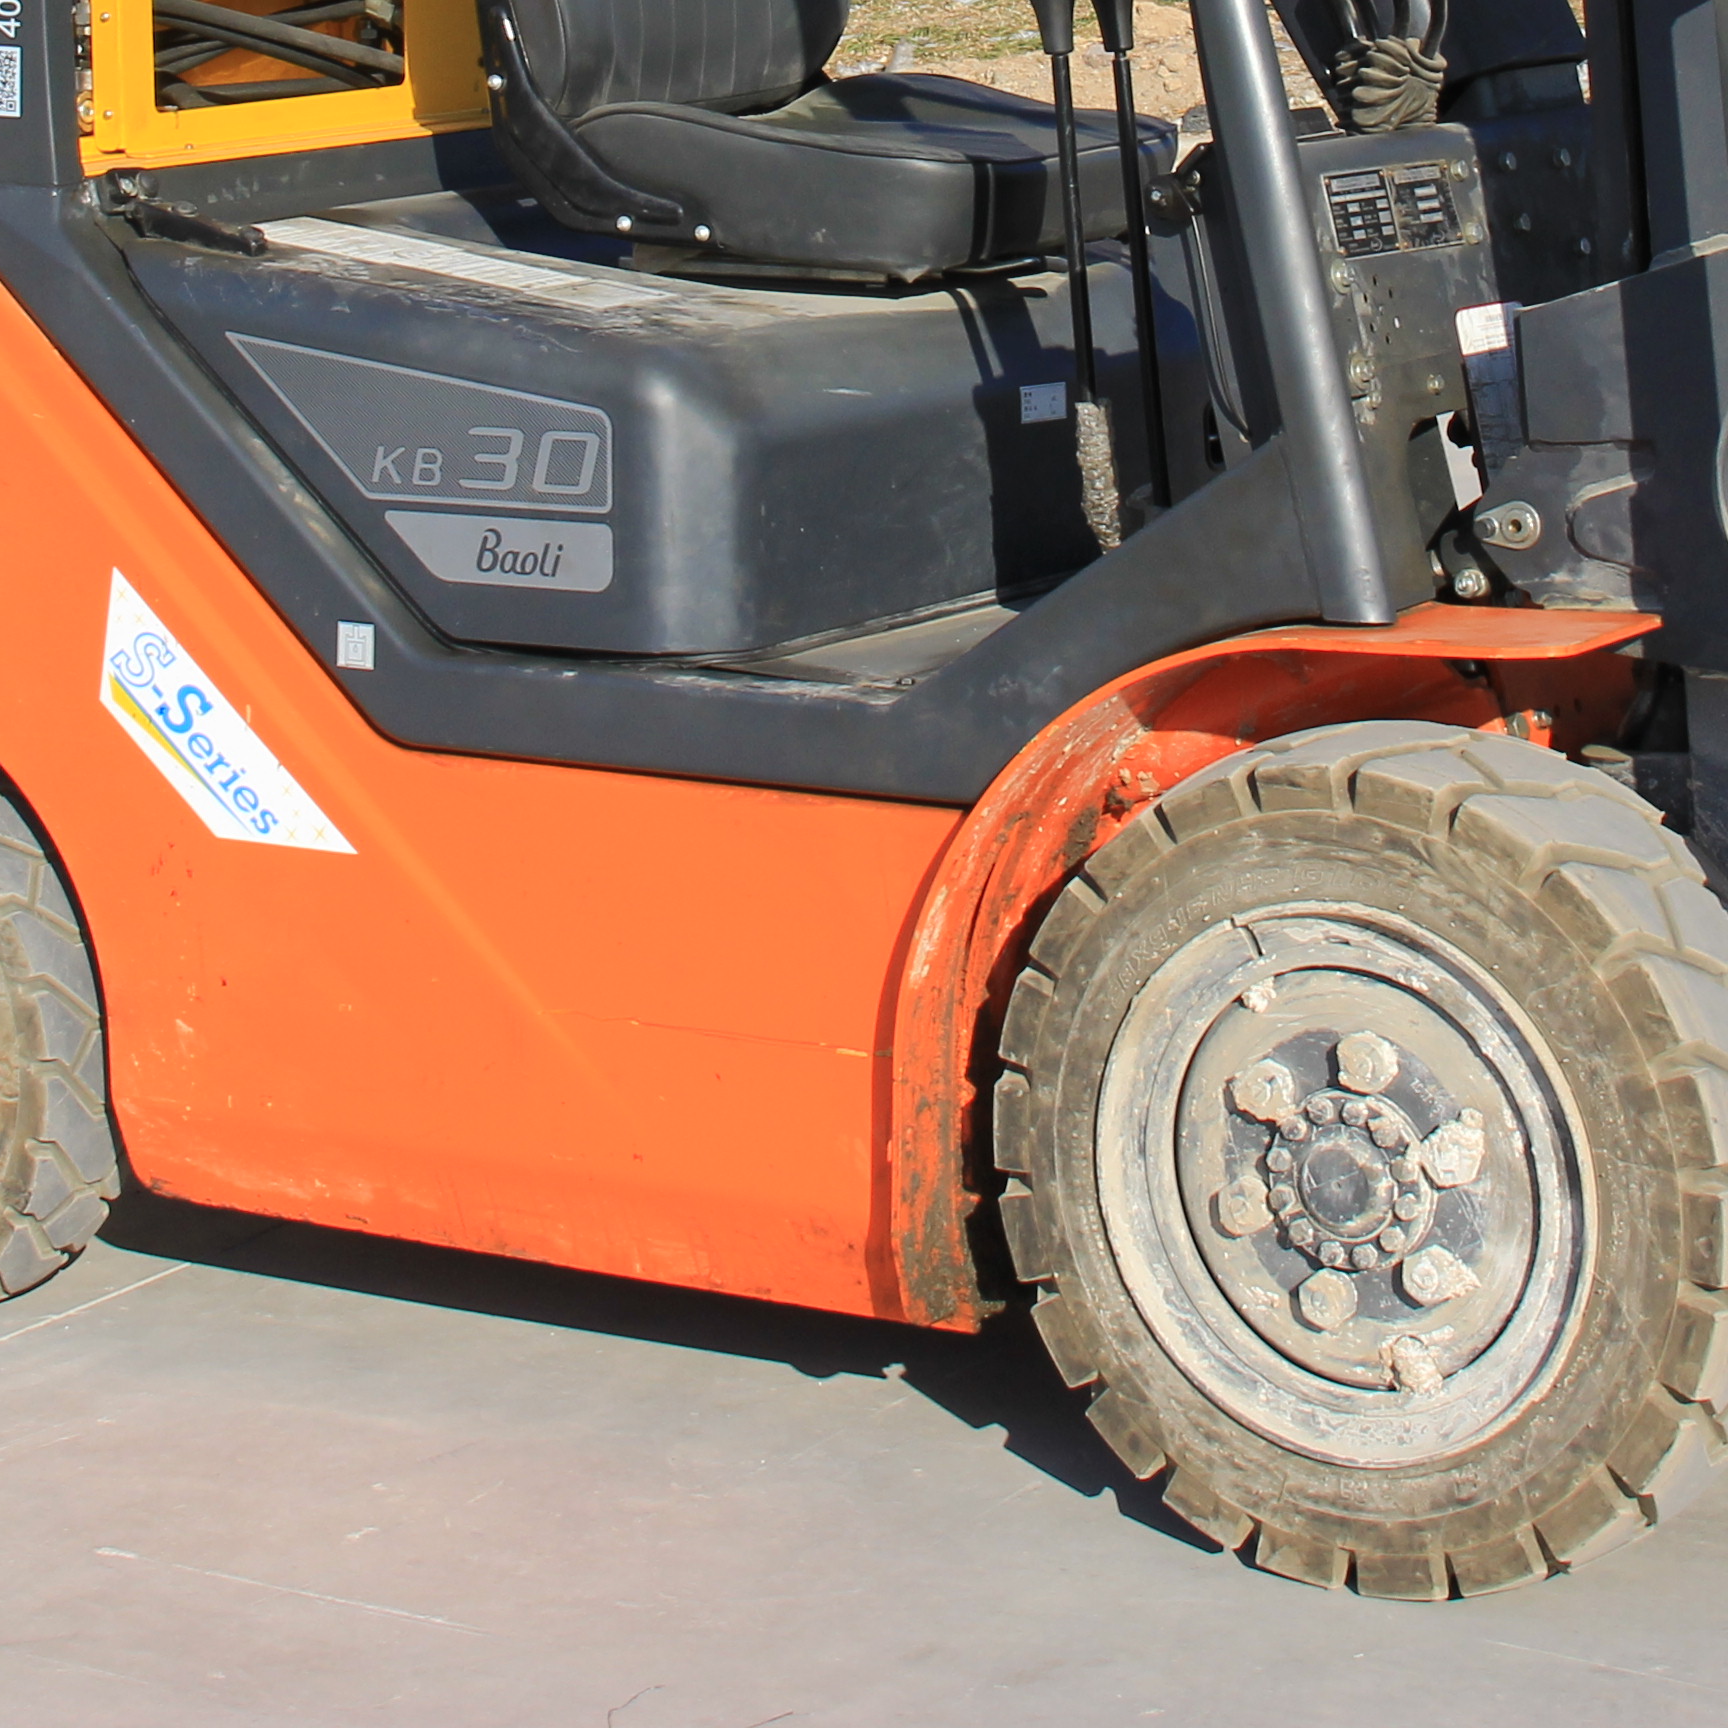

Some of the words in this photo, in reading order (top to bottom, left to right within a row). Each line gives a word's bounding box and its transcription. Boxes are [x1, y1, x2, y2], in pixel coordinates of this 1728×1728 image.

[369, 444, 443, 487] KB
[456, 425, 601, 496] 30
[475, 527, 563, 579] Baoli
[110, 632, 279, 835] S-Series
